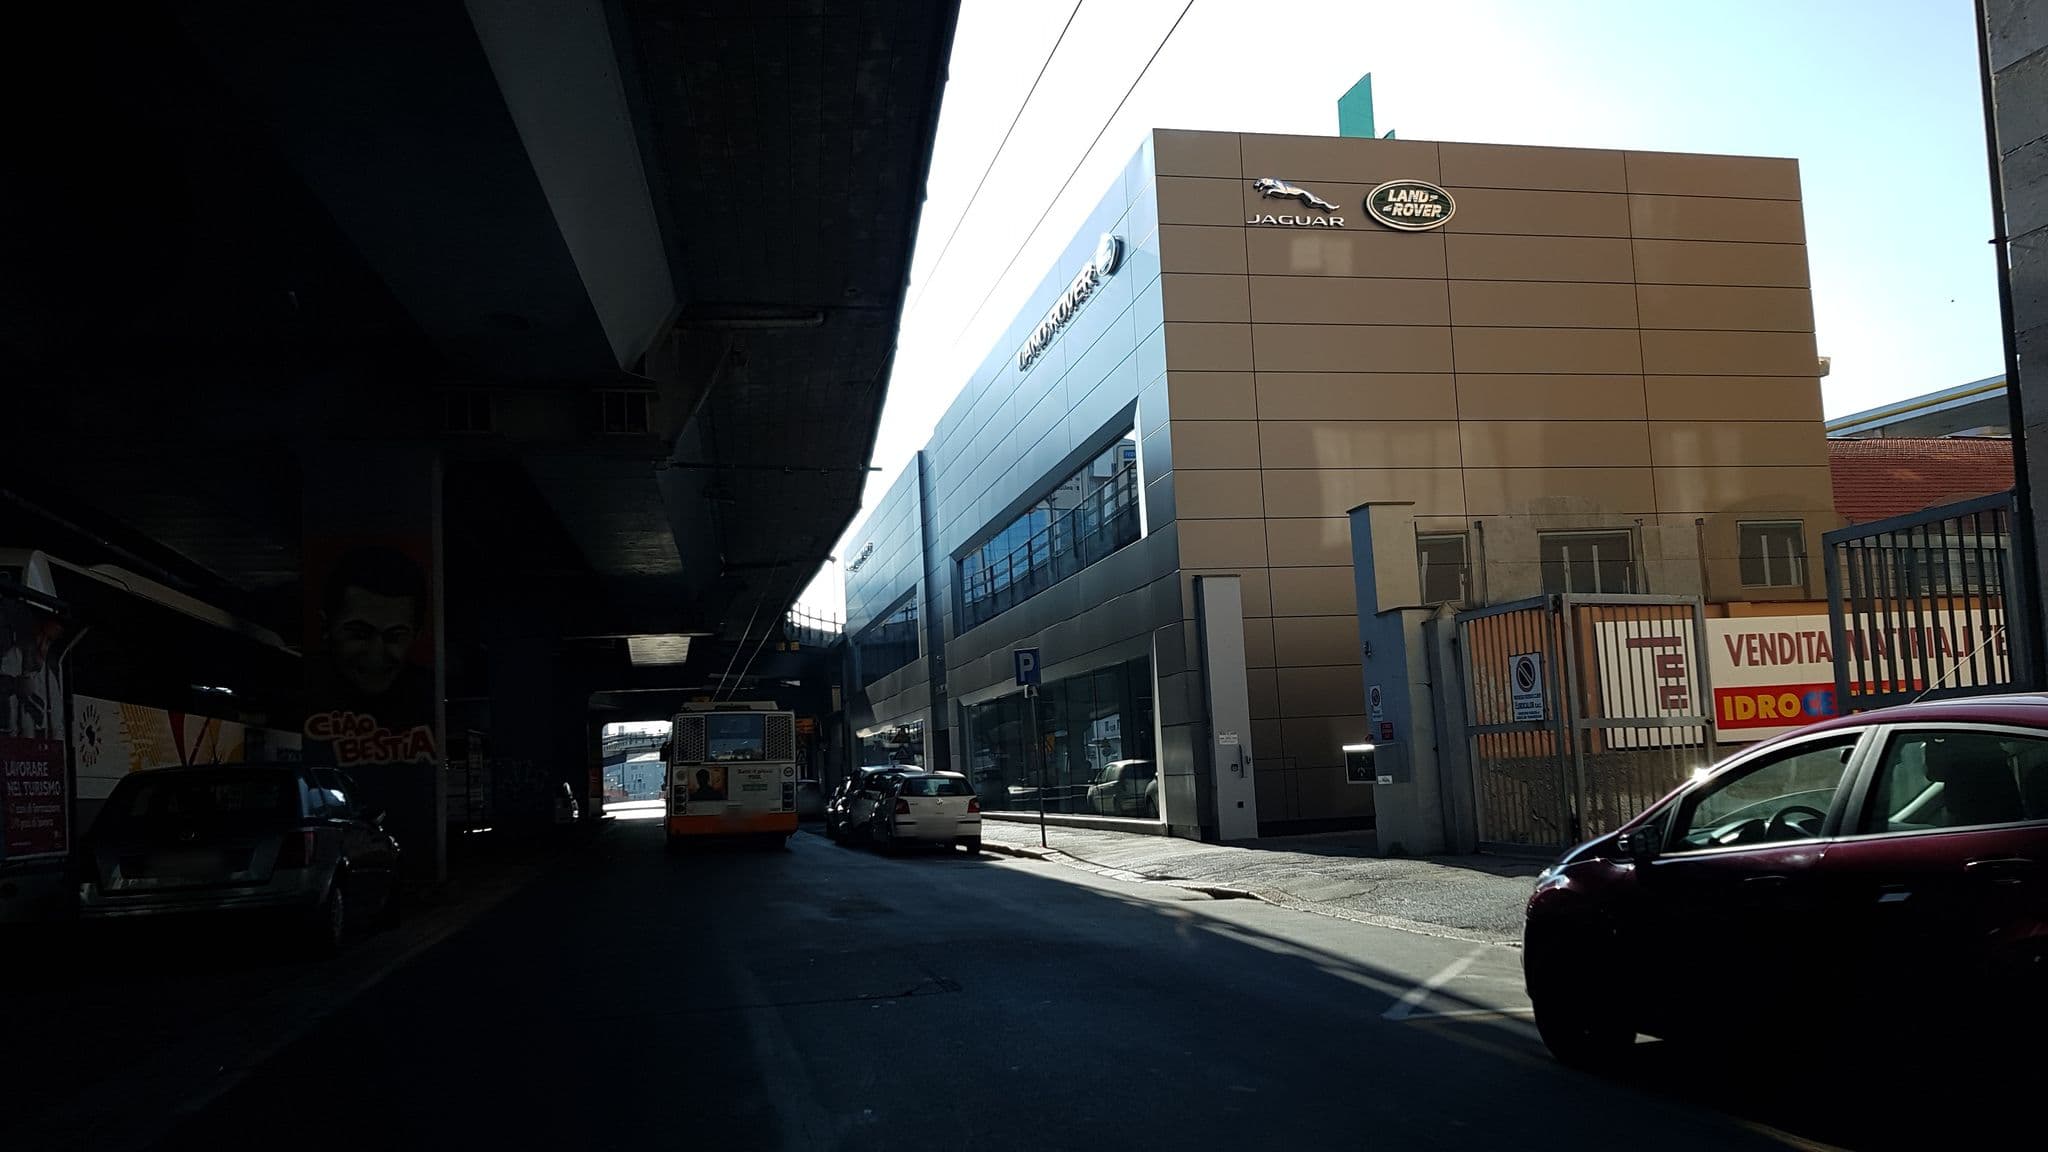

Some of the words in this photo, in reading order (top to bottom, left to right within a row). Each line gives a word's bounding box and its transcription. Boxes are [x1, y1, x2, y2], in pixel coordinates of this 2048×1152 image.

[1388, 189, 1430, 203] LAND
[1392, 203, 1441, 217] ROVER
[1247, 214, 1345, 227] JAGUAR
[1724, 632, 1833, 667] VENDITA
[1019, 652, 1035, 682] P
